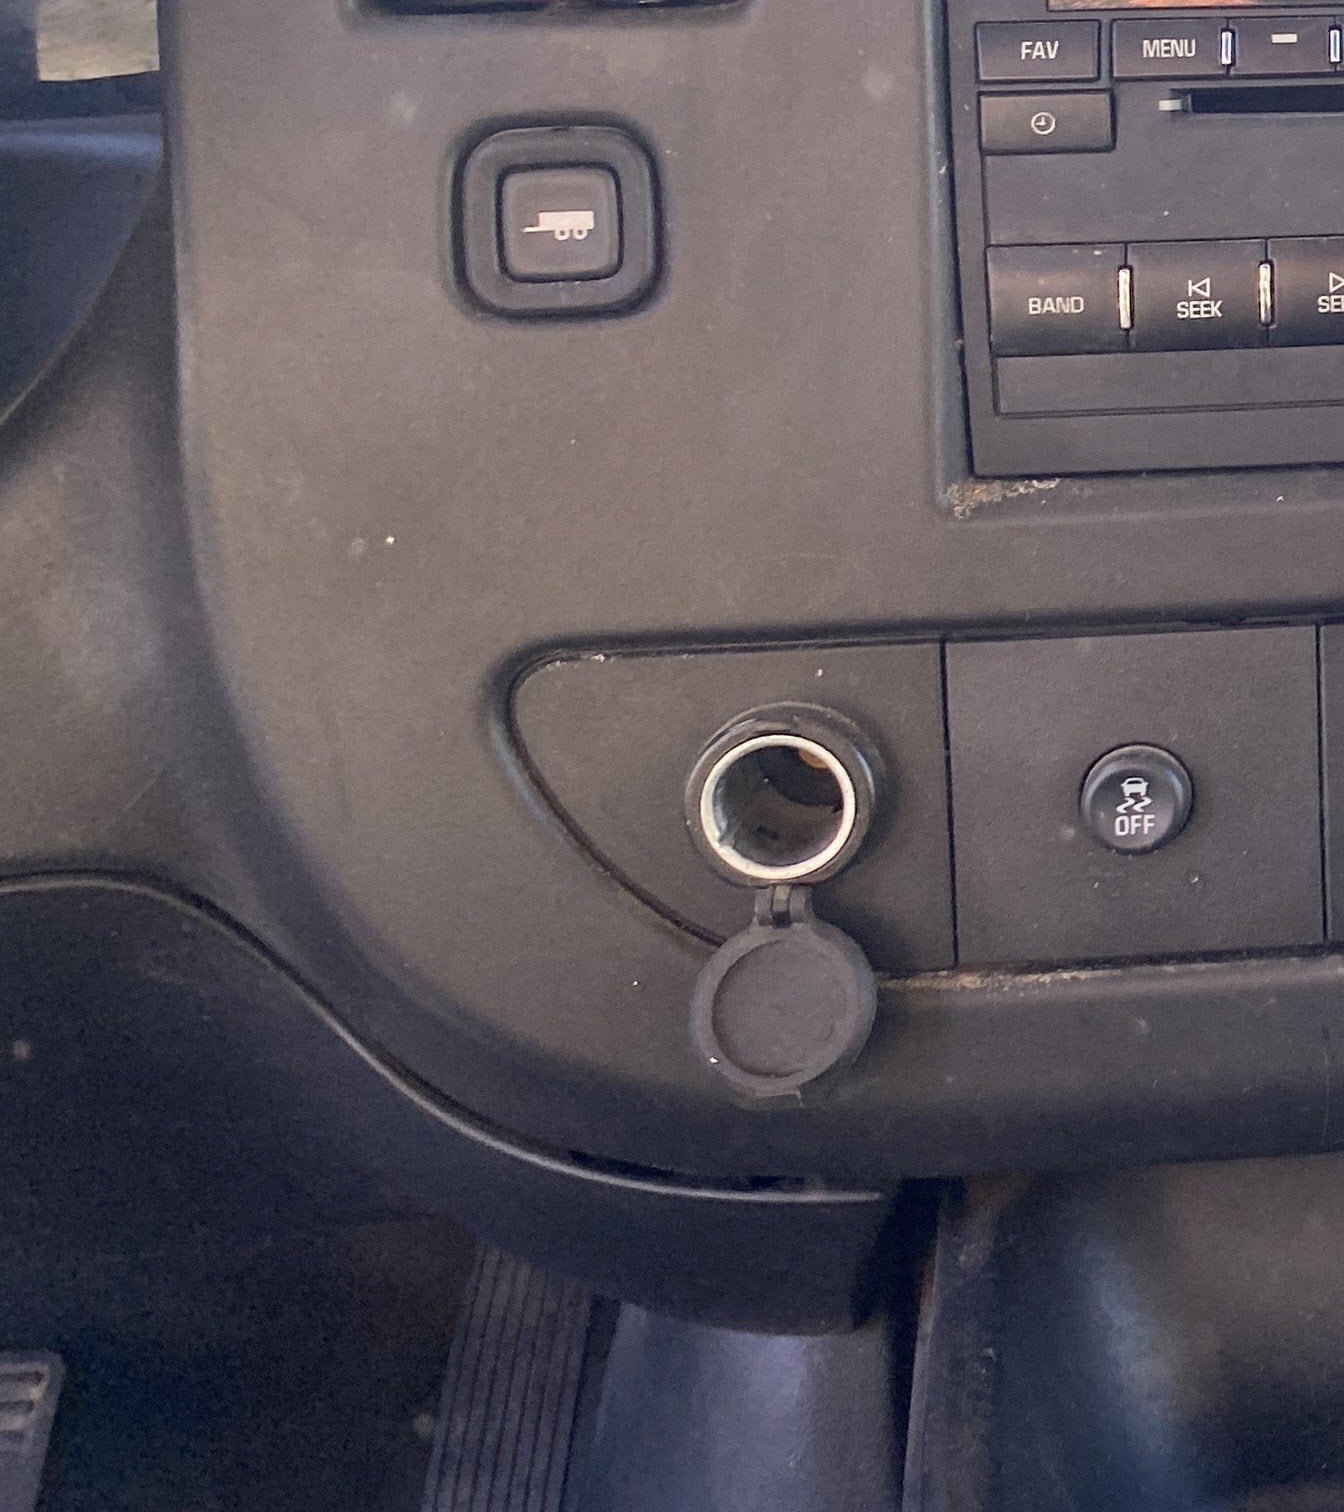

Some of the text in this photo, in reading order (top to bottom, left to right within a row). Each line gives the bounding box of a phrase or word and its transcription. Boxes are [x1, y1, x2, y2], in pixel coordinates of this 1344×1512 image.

[1020, 40, 1059, 60] FAV
[1142, 38, 1196, 59] MENU
[1028, 296, 1085, 315] BAND
[1176, 300, 1223, 319] SEEK
[1114, 814, 1156, 837] OFF
